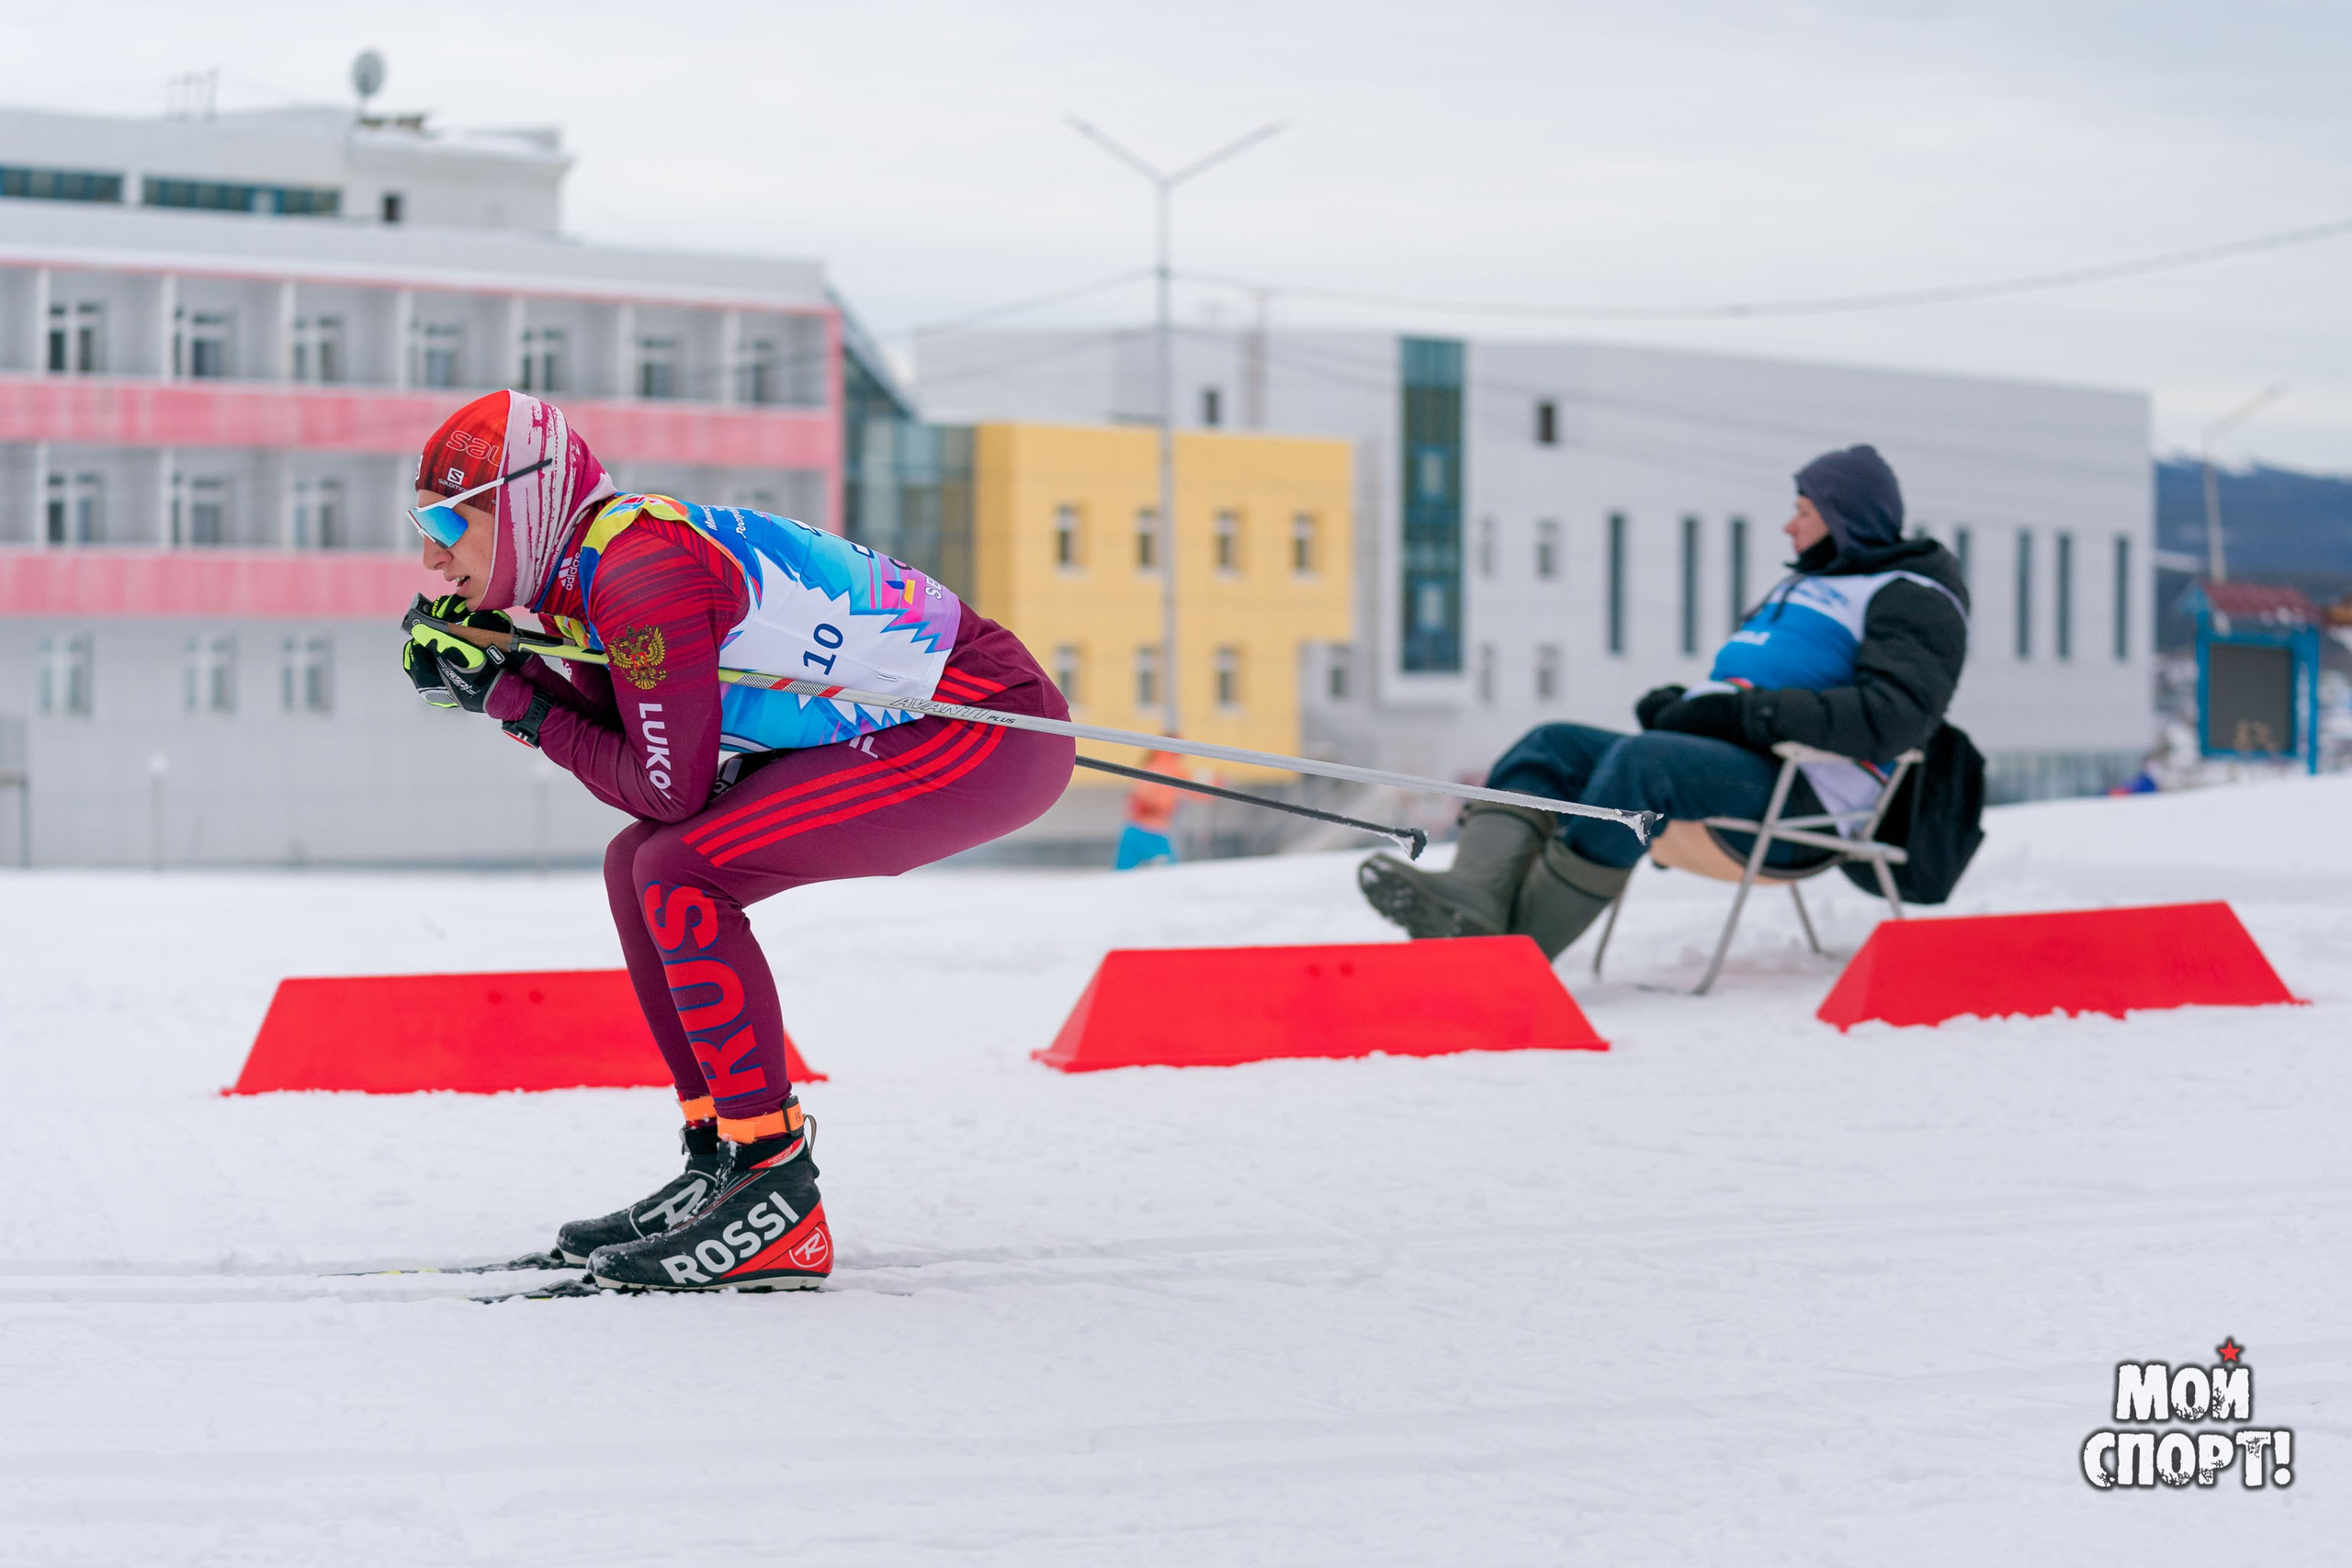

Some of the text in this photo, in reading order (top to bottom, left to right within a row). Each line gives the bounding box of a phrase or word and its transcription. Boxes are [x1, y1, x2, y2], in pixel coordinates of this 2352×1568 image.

[565, 551, 581, 591] adidas
[802, 622, 844, 676] 10
[889, 696, 1017, 725] AVANTI PLUS
[638, 702, 673, 800] LUKO
[642, 879, 768, 1102] RUS
[660, 1190, 800, 1284] ROSSI
